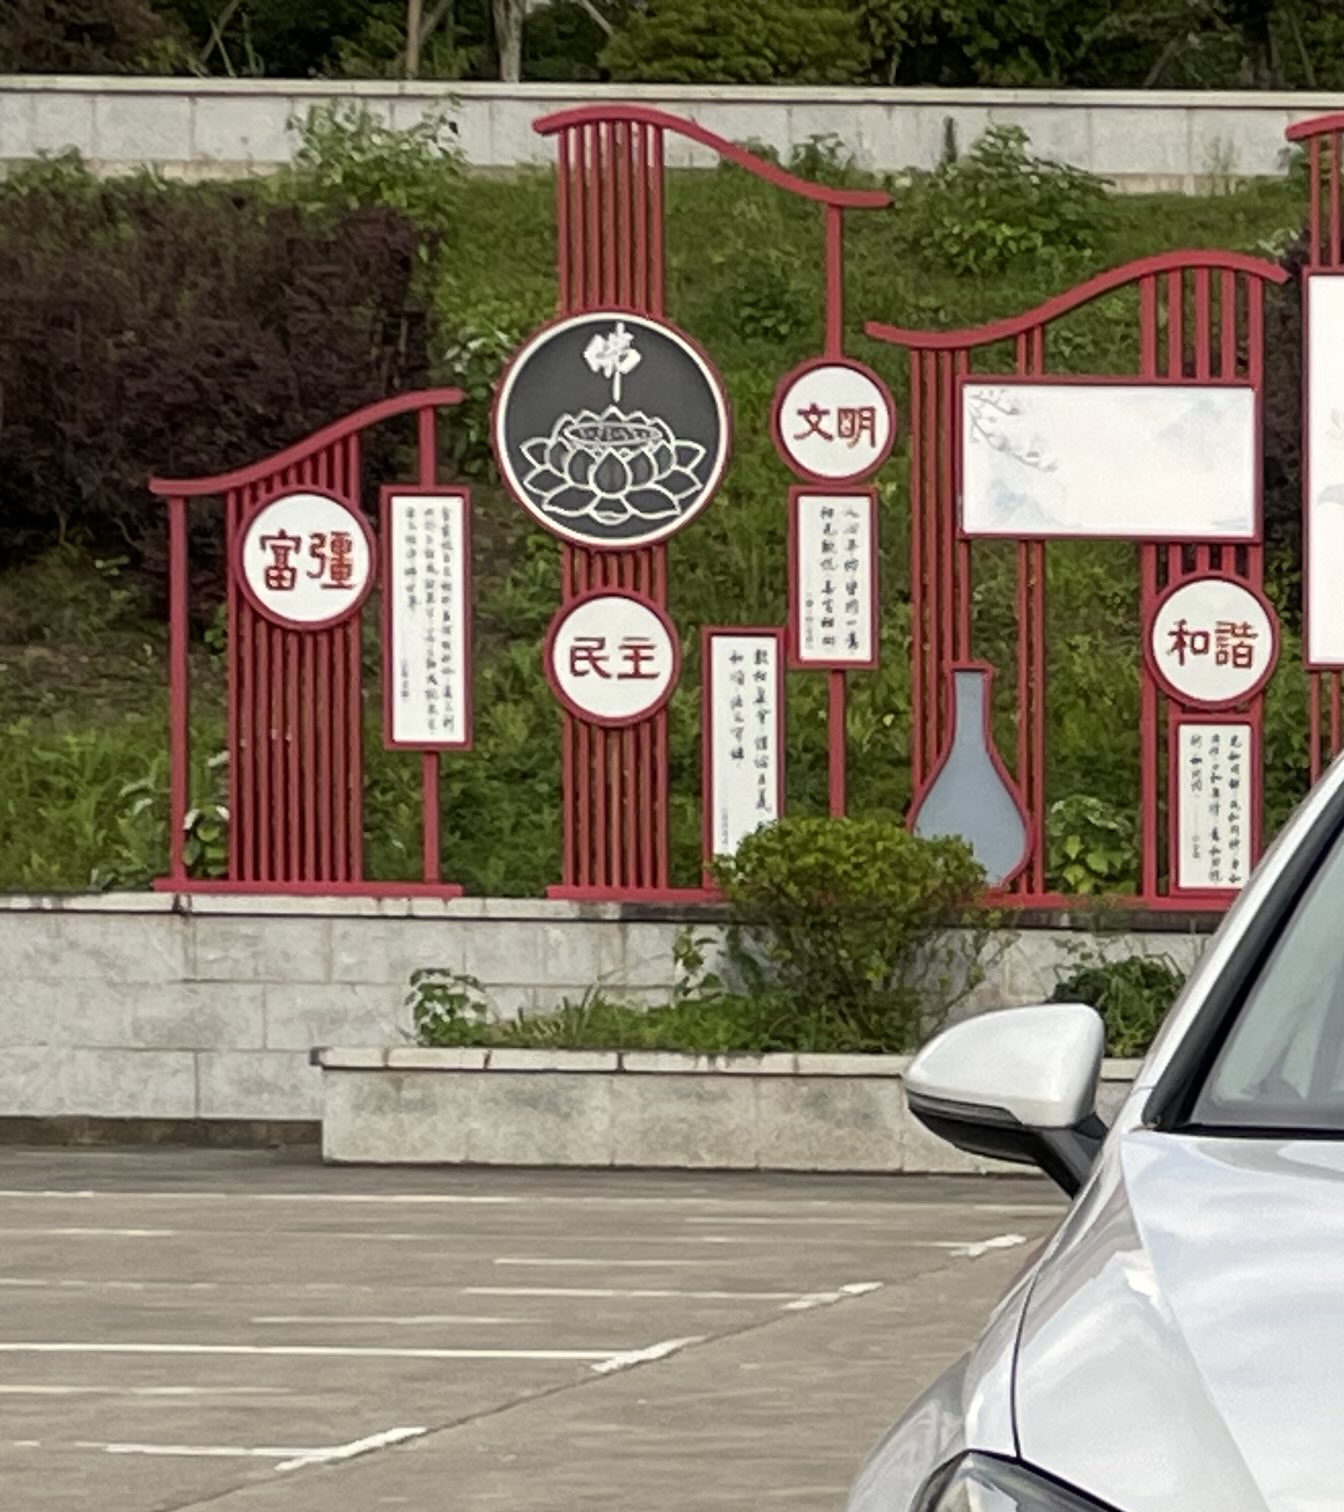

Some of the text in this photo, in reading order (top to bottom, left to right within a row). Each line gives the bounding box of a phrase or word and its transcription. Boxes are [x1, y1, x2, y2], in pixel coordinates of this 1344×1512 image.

[583, 322, 642, 402] 佛
[793, 402, 876, 448] 文明
[570, 636, 661, 679] 民主
[1166, 618, 1259, 669] 和諧
